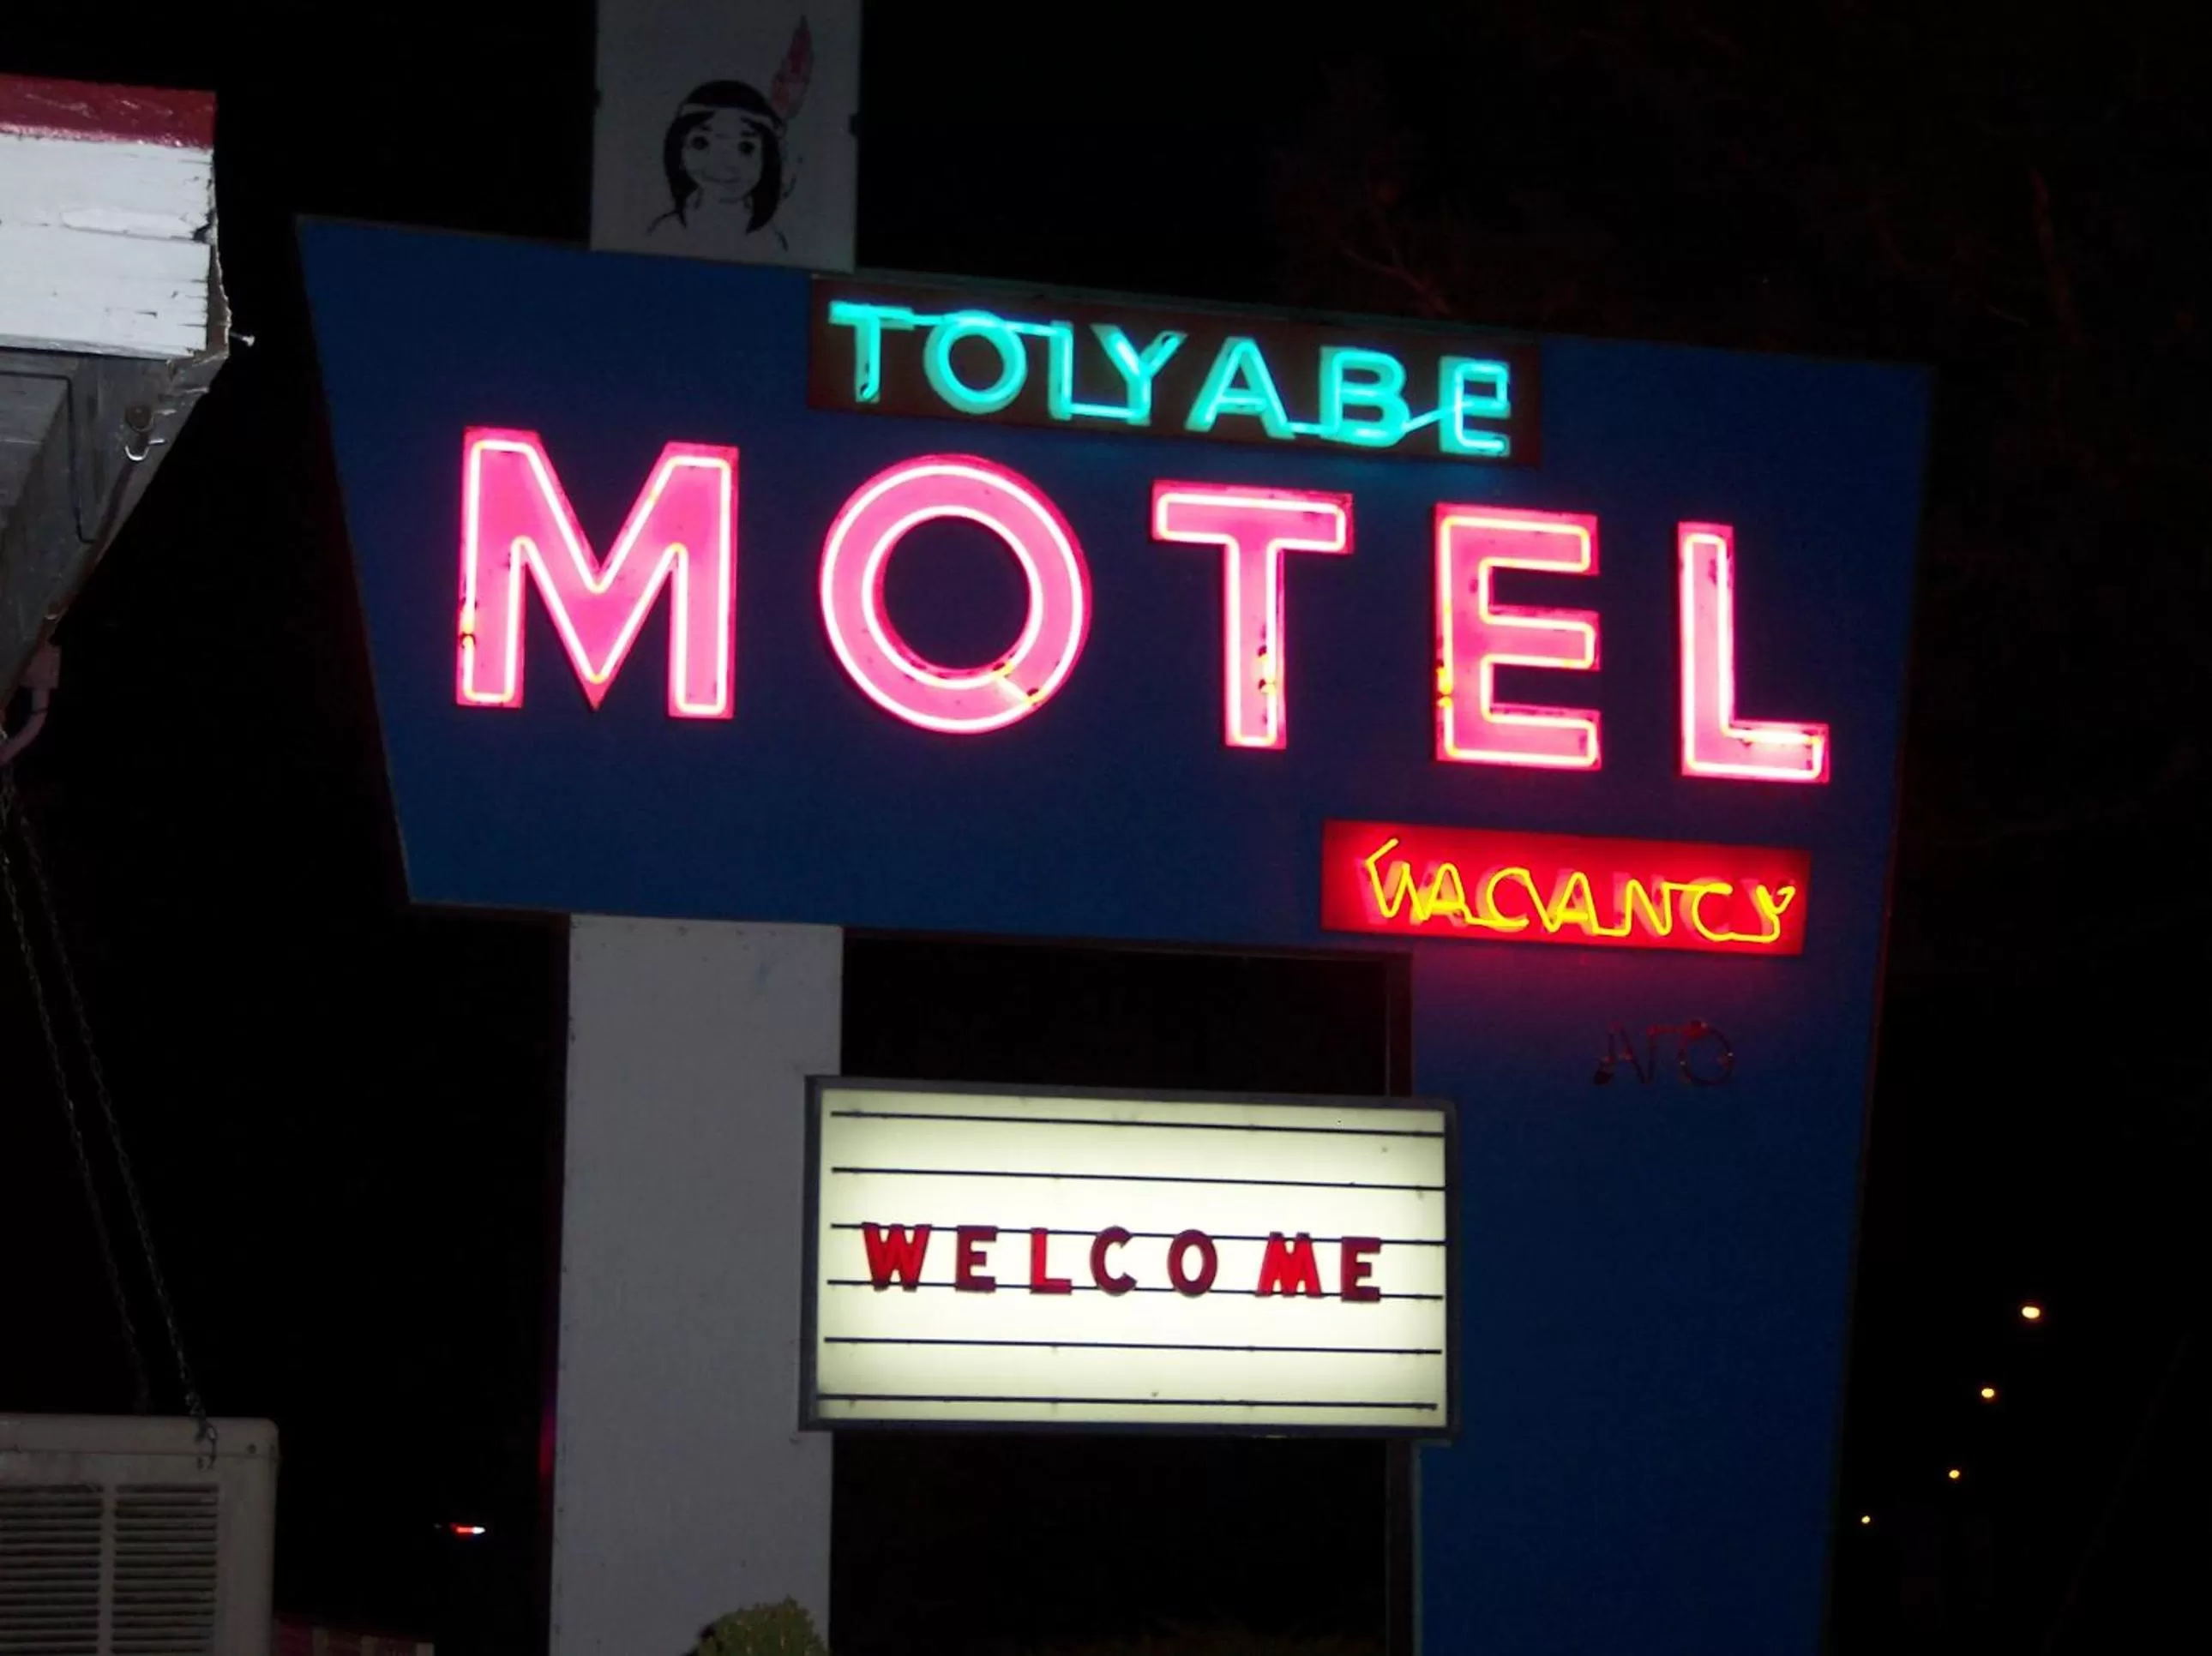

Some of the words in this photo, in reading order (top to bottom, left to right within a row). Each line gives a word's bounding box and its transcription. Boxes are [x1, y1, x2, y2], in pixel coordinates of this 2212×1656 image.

[455, 426, 1830, 784] MOTEL
[1356, 837, 1797, 945] VACANCY
[861, 1223, 1382, 1303] WELCOME
